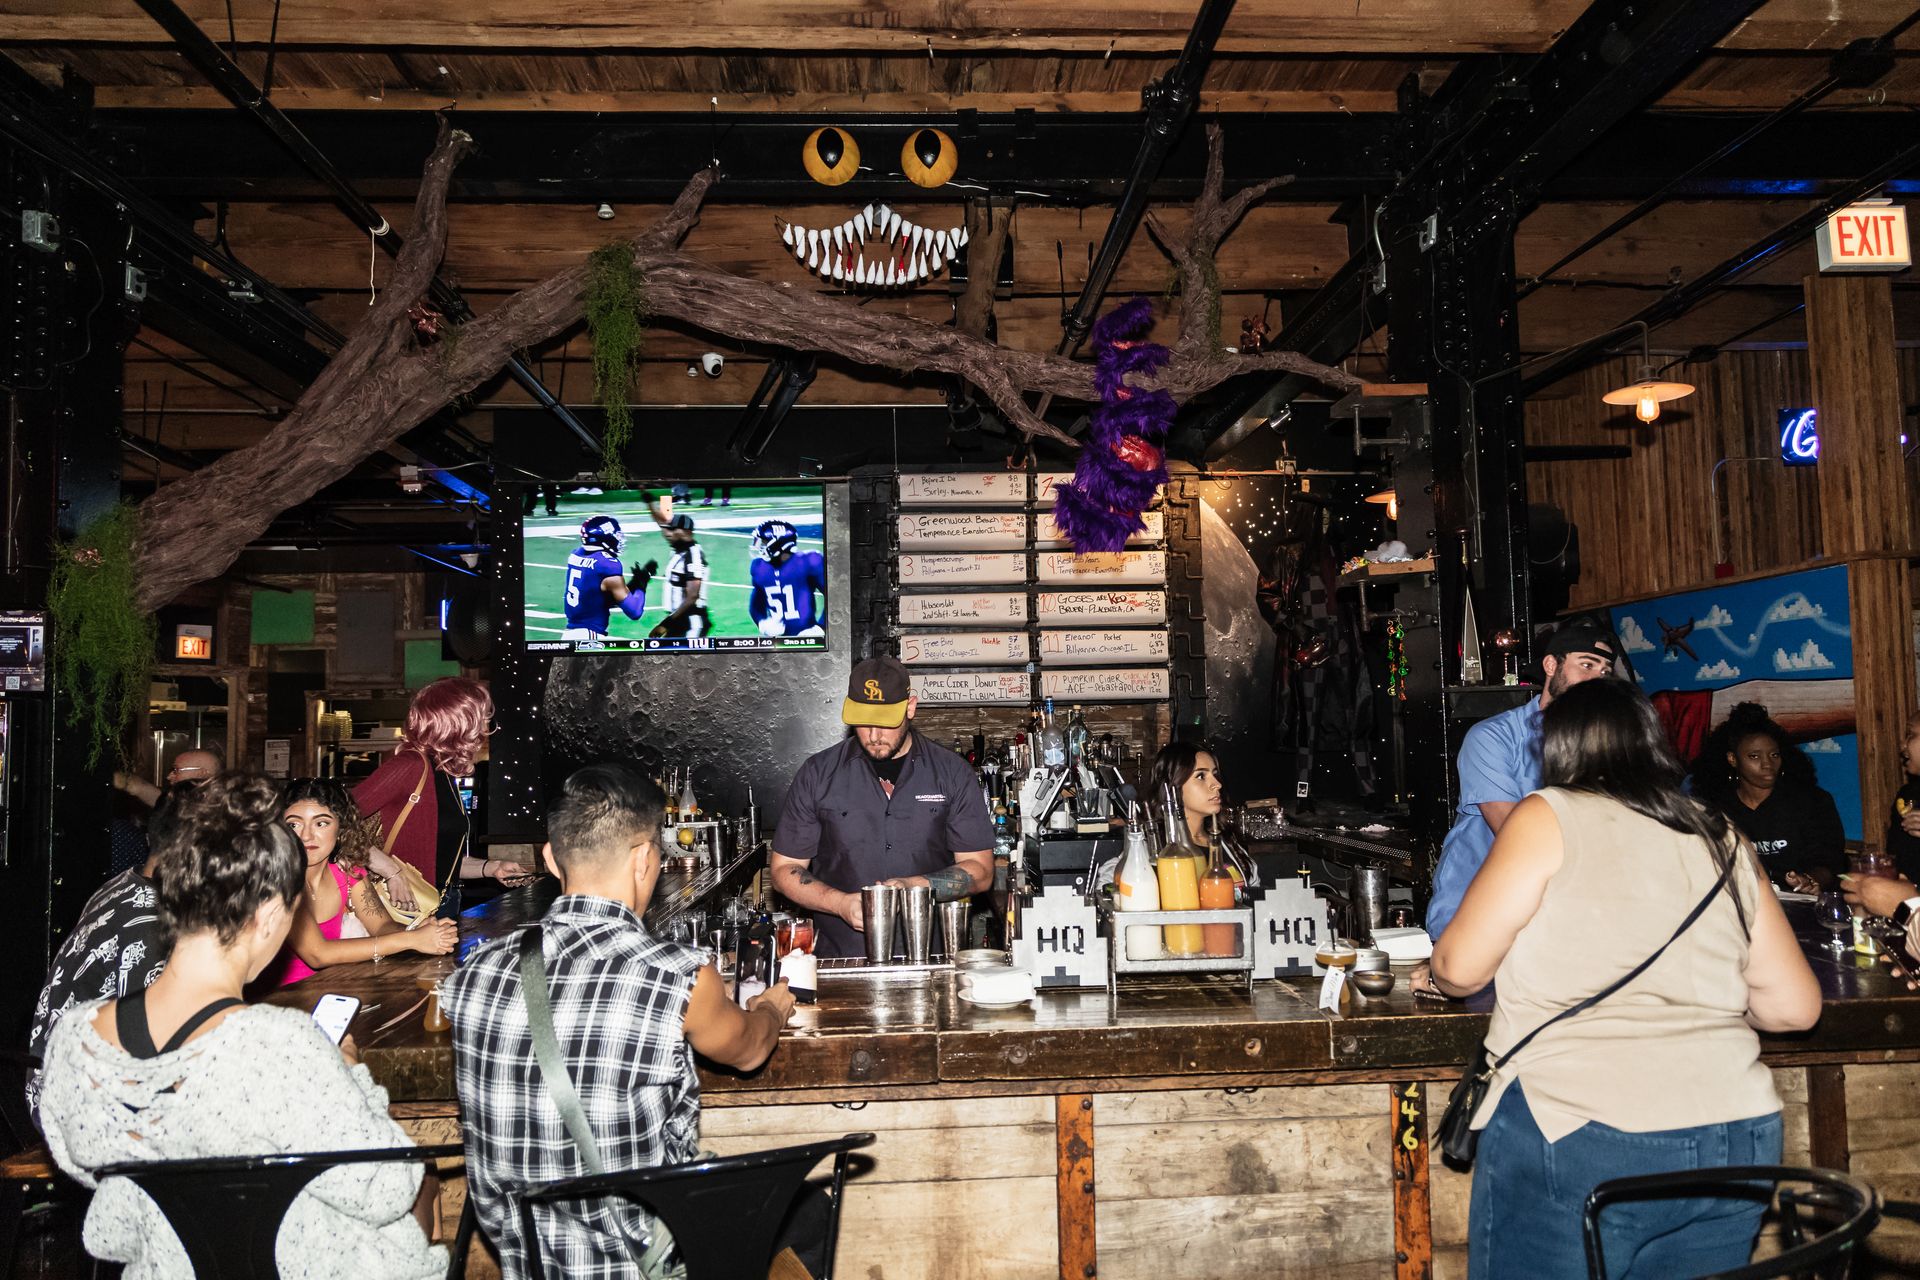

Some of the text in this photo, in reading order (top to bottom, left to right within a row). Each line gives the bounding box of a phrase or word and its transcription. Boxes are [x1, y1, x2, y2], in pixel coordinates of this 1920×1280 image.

[1836, 216, 1896, 257] EXIT
[1042, 476, 1054, 497] 7
[903, 517, 916, 537] 2
[919, 516, 1000, 527] Greenwood Beach
[902, 556, 914, 577] 3
[567, 568, 582, 608] 5
[764, 584, 800, 621] 51
[1108, 593, 1127, 605] RED
[906, 600, 919, 621] 4
[182, 639, 208, 656] EXIT
[630, 641, 640, 649] 0
[650, 641, 660, 649] 0
[923, 639, 939, 649] Free
[1043, 634, 1064, 654] 11
[1065, 634, 1122, 642] Eleanor Porter
[906, 640, 920, 662] 5
[946, 675, 969, 689] CIDER
[974, 675, 998, 688] DONUT
[1046, 675, 1064, 694] 12
[1065, 684, 1087, 694] ACE
[1037, 925, 1084, 955] HQ
[1269, 917, 1316, 947] HQ
